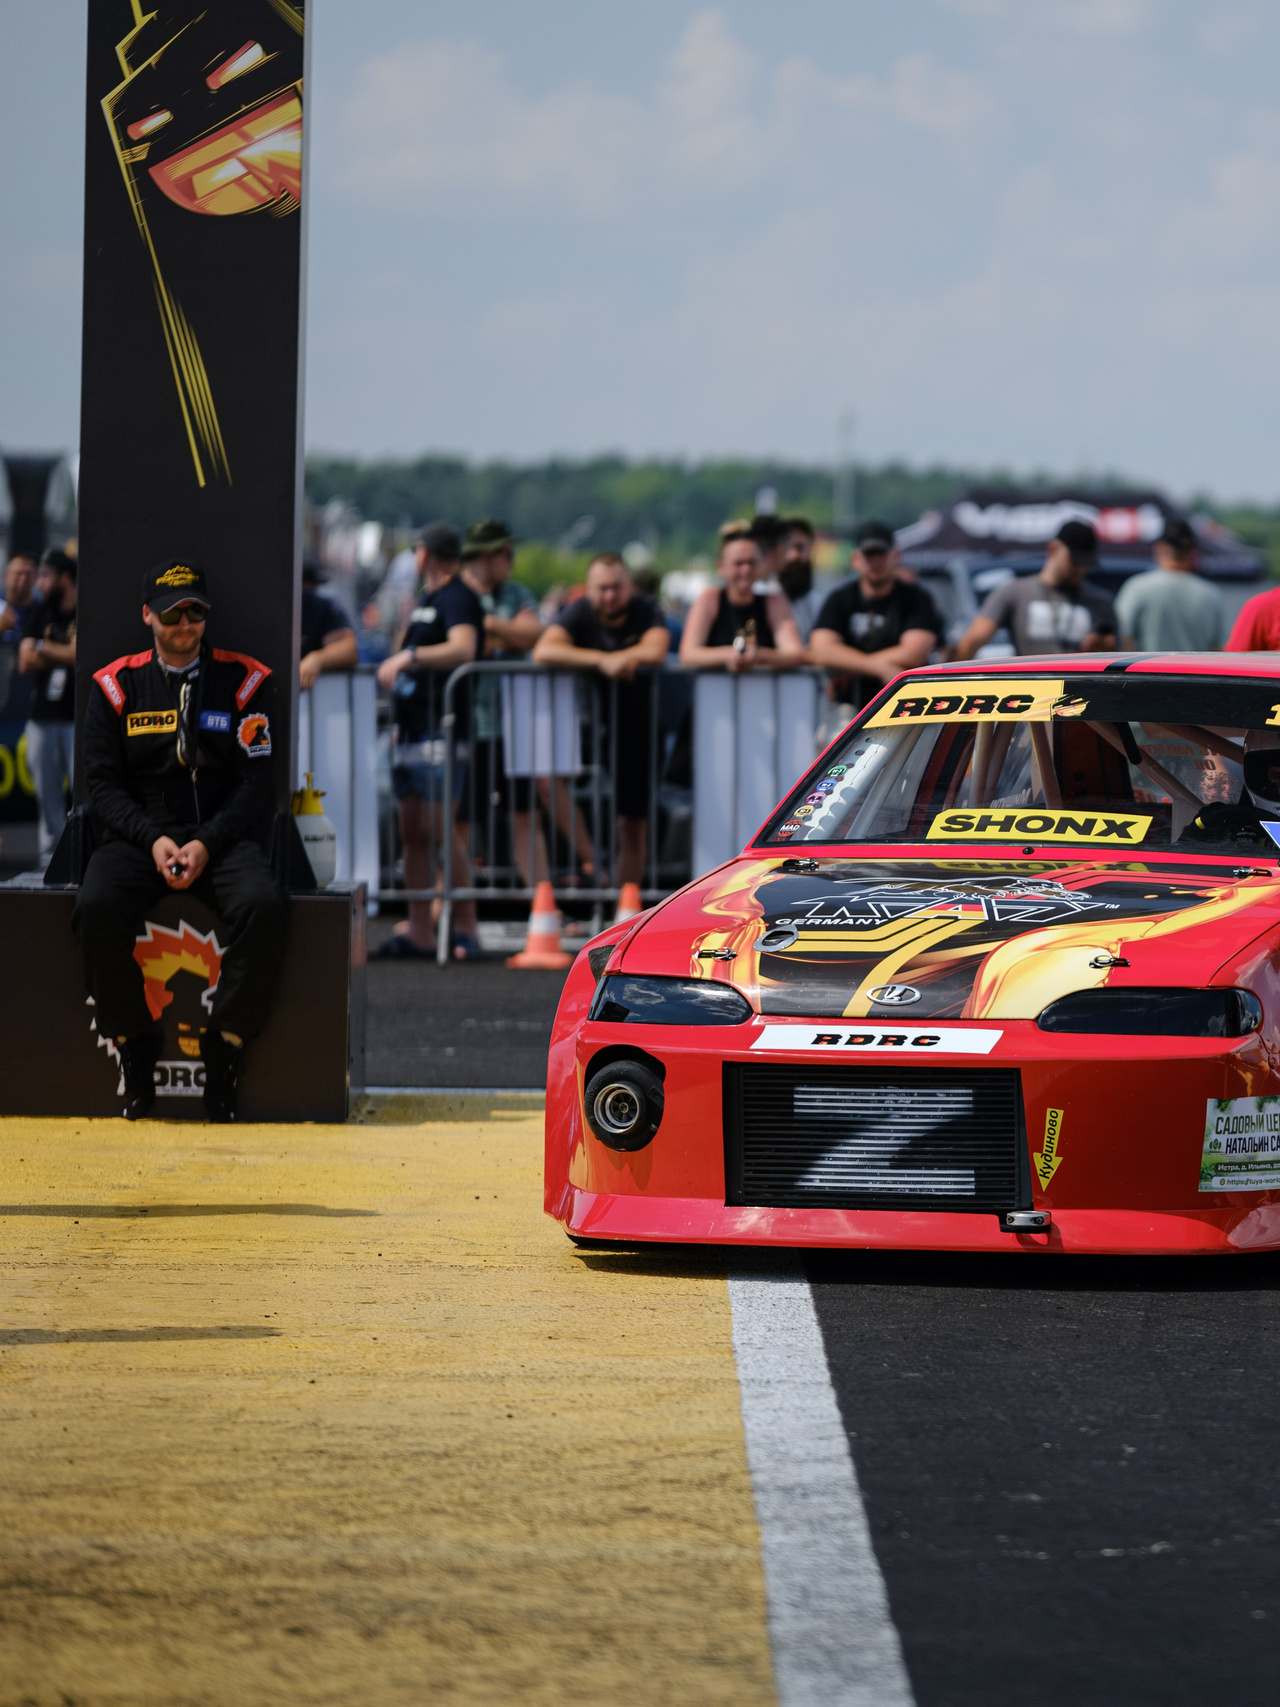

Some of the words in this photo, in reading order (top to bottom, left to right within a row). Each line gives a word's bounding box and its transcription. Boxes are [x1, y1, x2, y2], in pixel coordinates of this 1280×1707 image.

[890, 694, 1035, 718] RDRC
[129, 713, 176, 729] RDRC
[207, 715, 228, 729] ВТБ
[779, 824, 801, 832] MAD
[939, 814, 1138, 840] SHONX
[811, 1033, 942, 1047] RDRC
[1038, 1109, 1059, 1180] Кудиново
[1225, 1136, 1269, 1154] НАТАЛЬИН
[1217, 1163, 1241, 1171] Истра,
